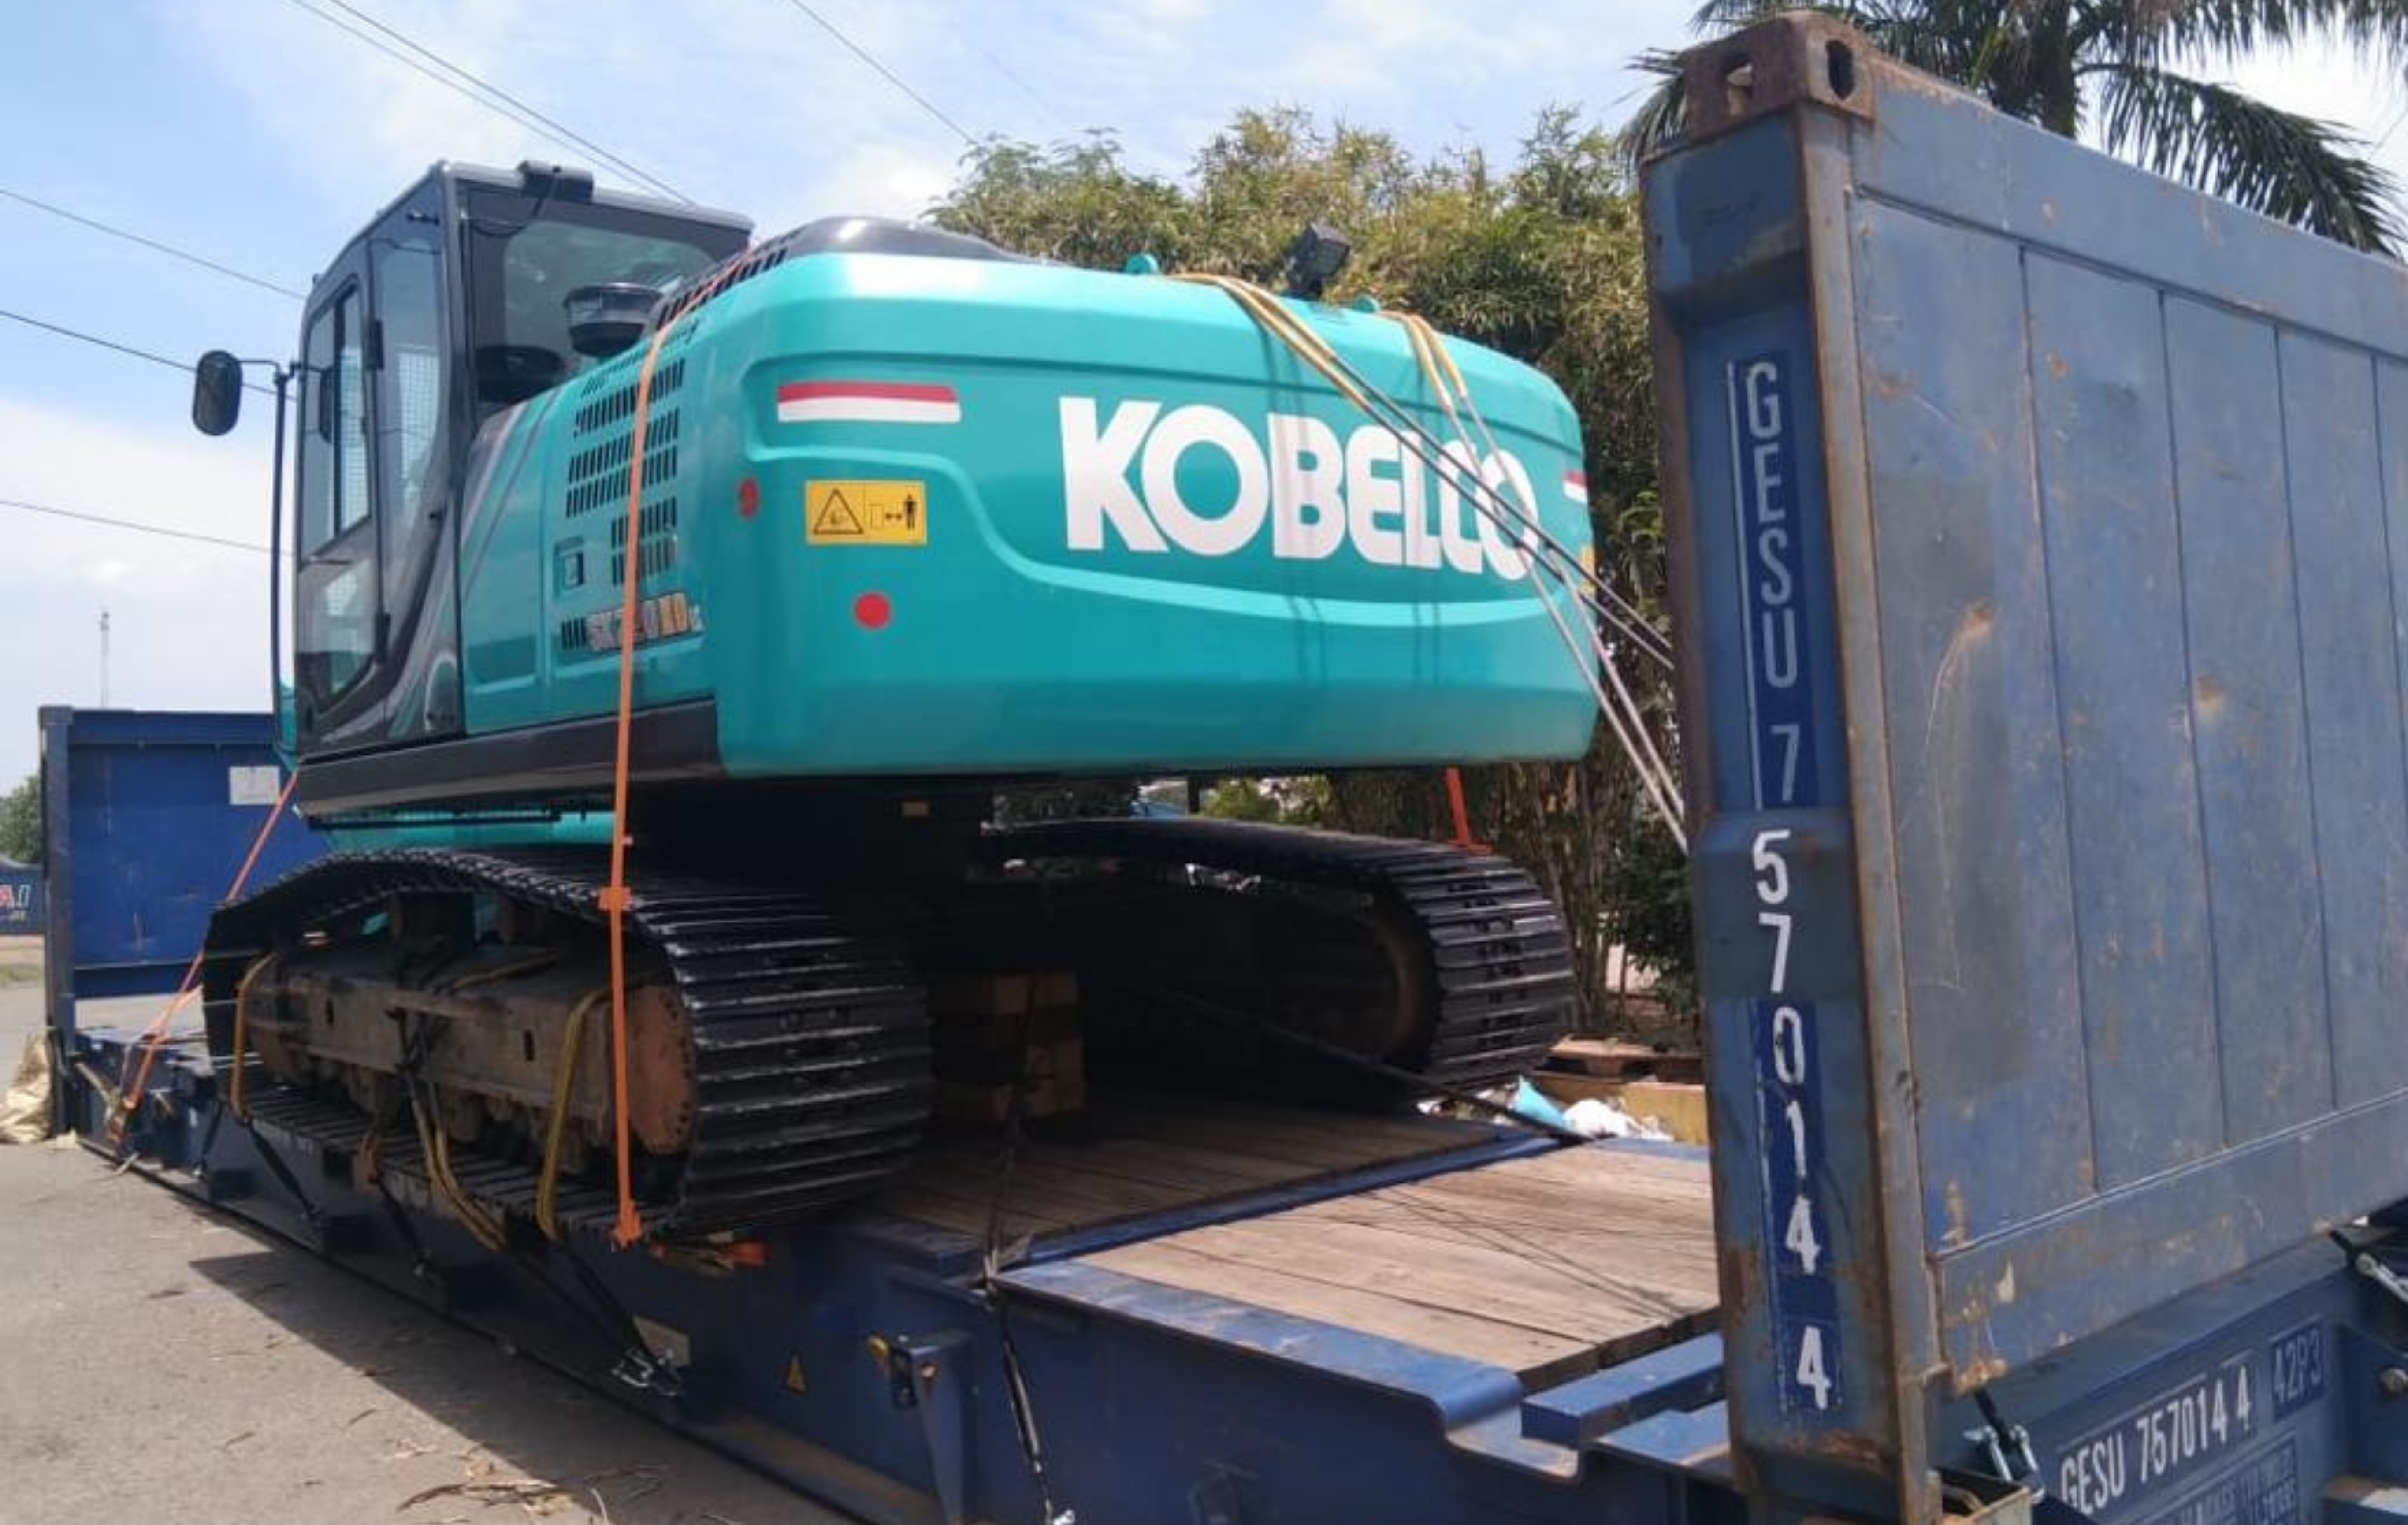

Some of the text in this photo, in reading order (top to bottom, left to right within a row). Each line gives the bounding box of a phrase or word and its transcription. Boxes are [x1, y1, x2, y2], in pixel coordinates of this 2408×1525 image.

[1059, 395, 1539, 580] KOBELCO
[1746, 361, 1798, 688] GESU
[2061, 1431, 2125, 1515] GESU
[2136, 1379, 2227, 1484] 757014
